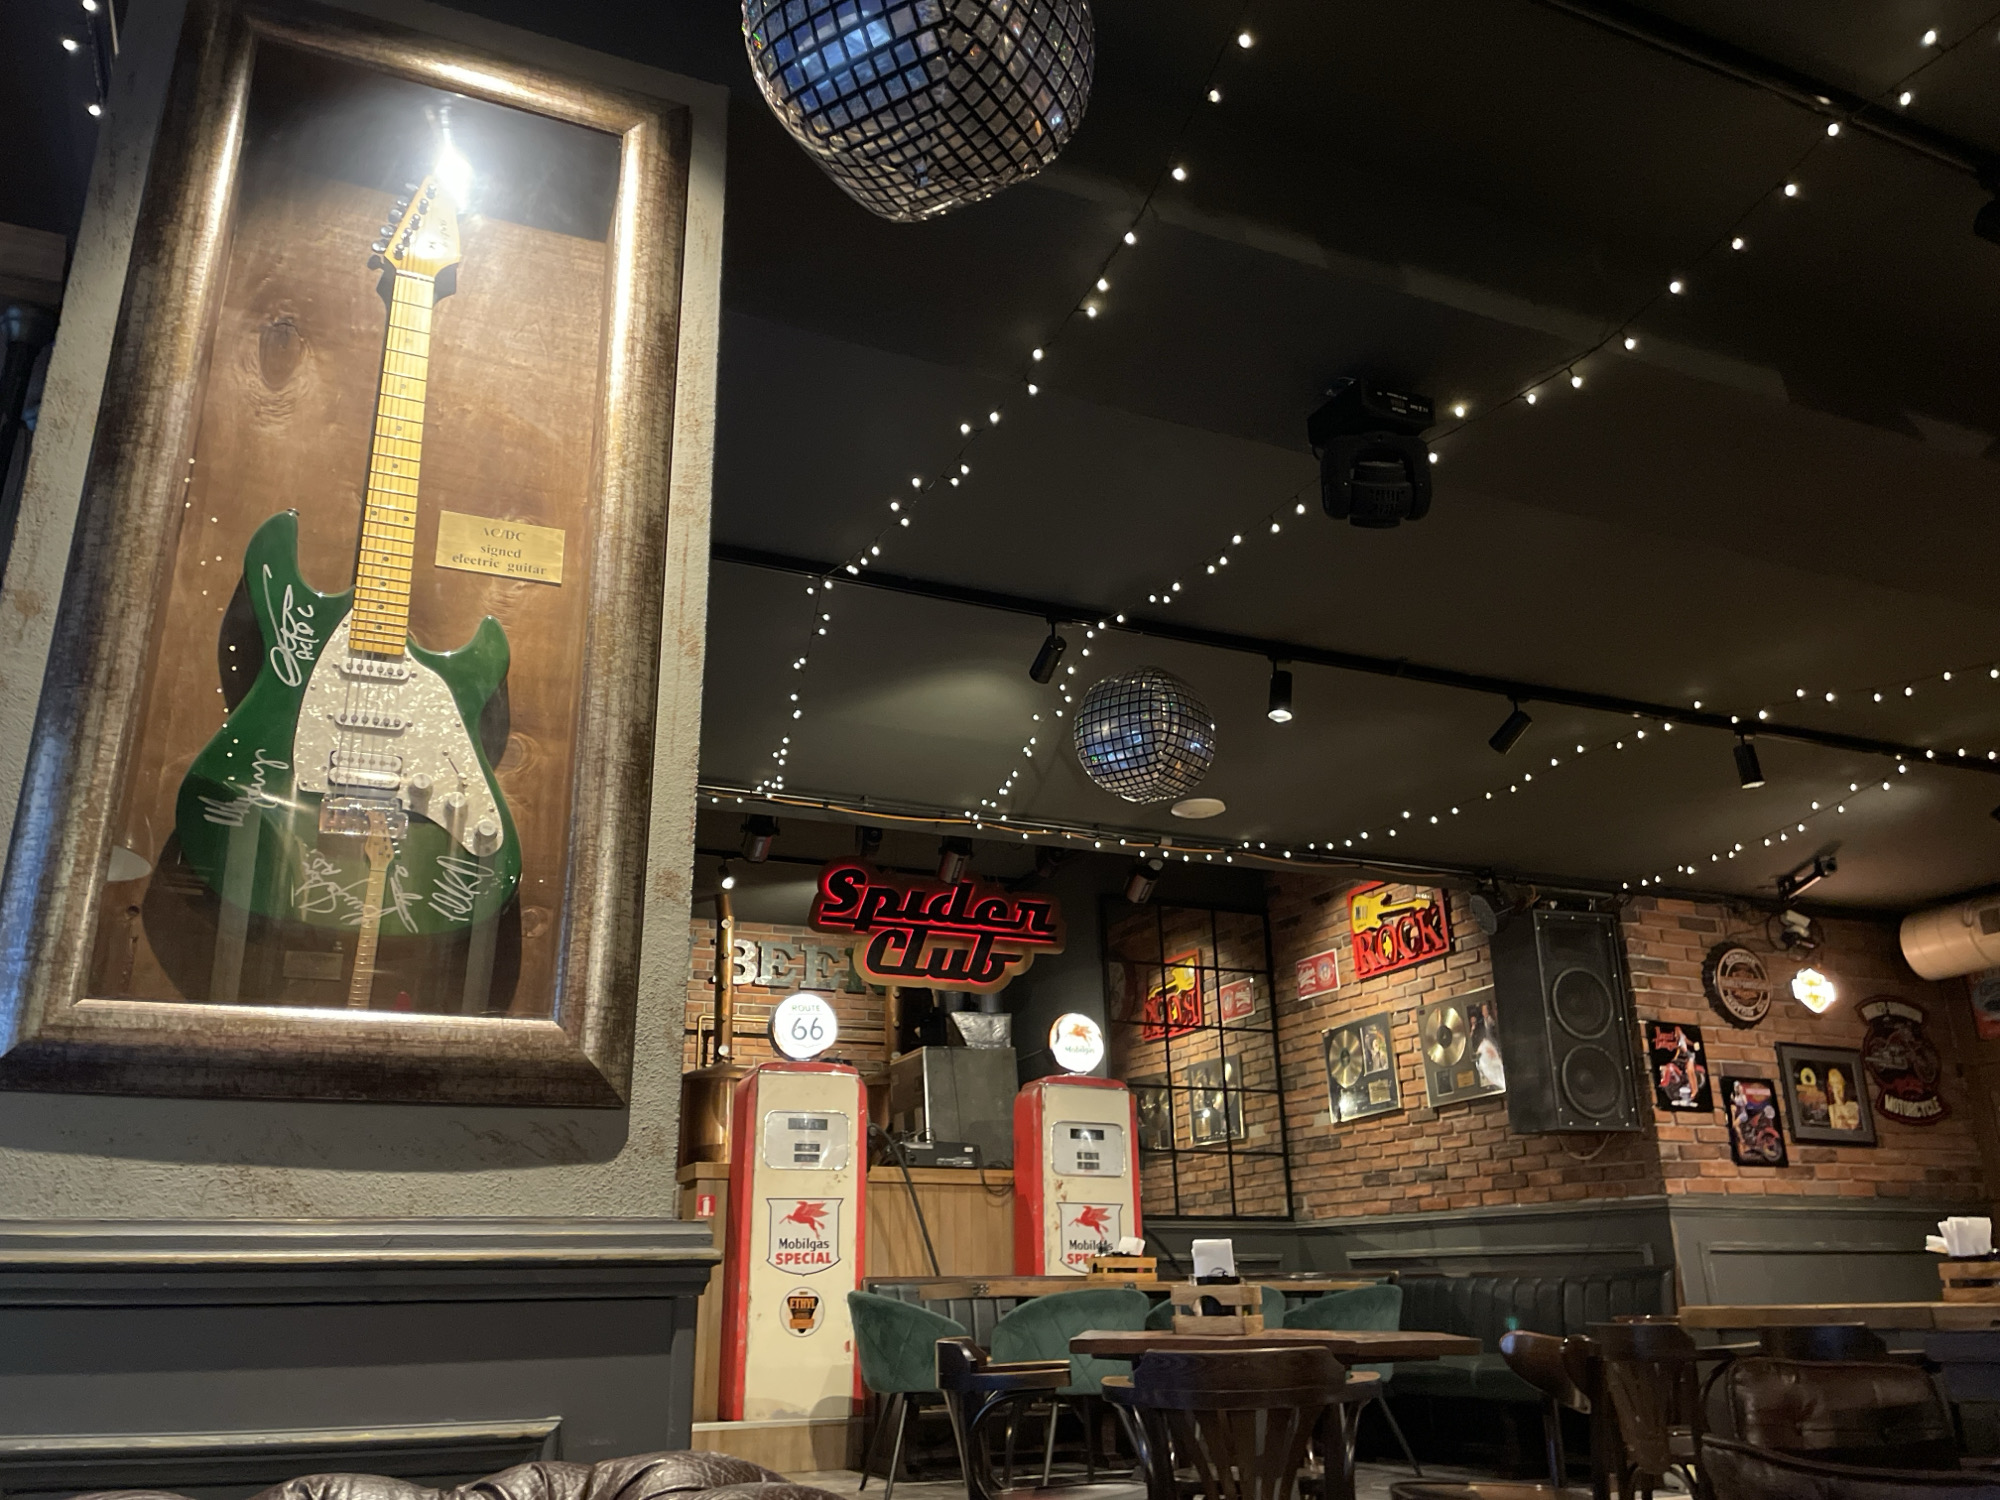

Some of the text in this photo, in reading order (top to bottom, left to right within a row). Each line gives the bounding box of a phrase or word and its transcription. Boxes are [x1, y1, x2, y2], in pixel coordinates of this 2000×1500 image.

[480, 527, 526, 542] AC/DC
[480, 544, 522, 559] signed
[452, 553, 548, 576] electric guitar
[821, 866, 1057, 933] Spider
[1353, 904, 1445, 975] ROCK
[865, 927, 1022, 984] Club
[791, 1004, 821, 1012] ROUTE
[791, 1017, 824, 1041] 66
[778, 1237, 830, 1252] Mobilgas
[775, 1252, 832, 1265] SPECIAL
[789, 1297, 816, 1310] ETHYL
